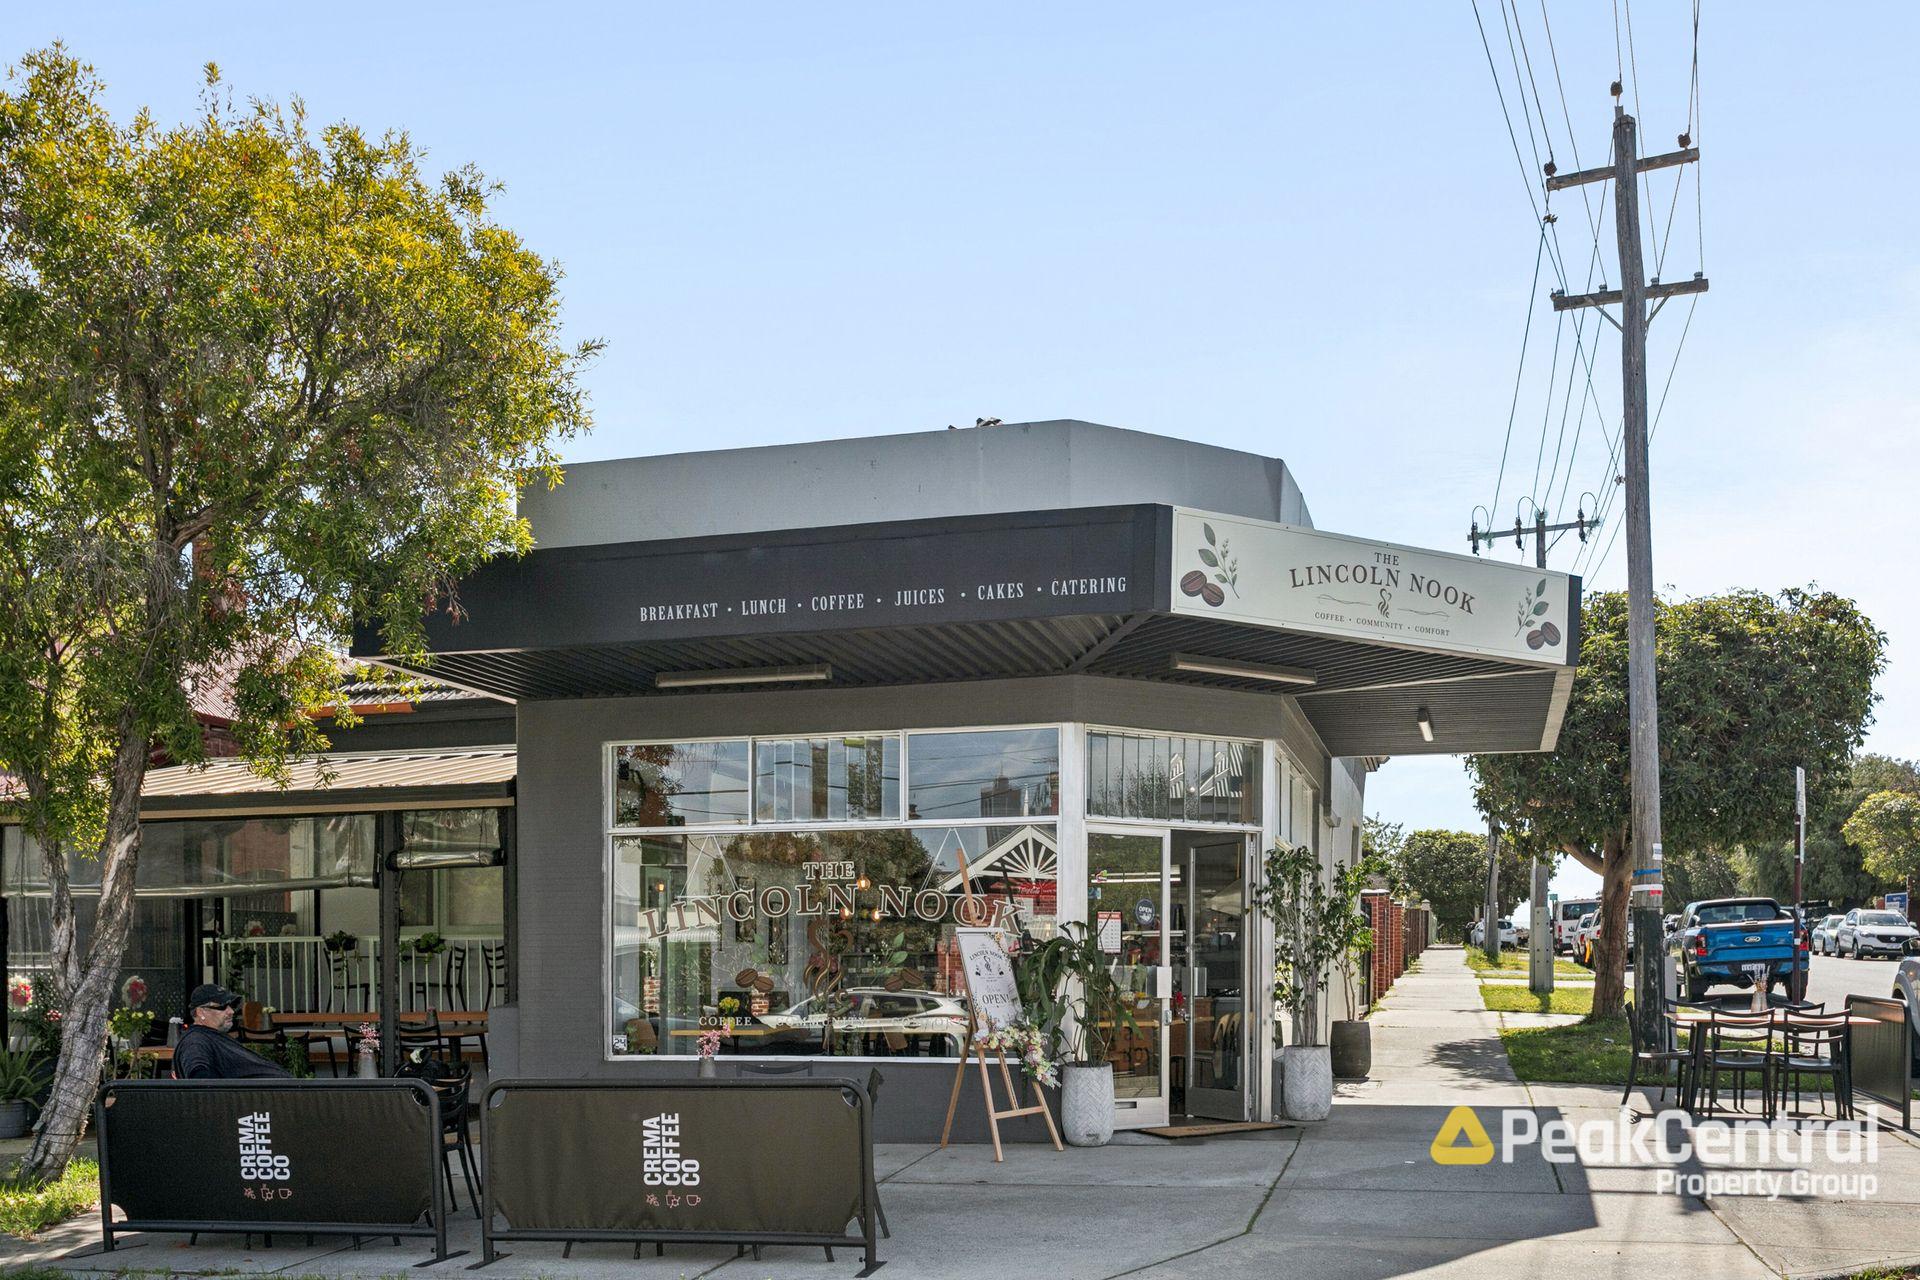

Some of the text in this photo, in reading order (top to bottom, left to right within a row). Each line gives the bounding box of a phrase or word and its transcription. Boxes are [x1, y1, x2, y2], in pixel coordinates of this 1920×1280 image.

[1374, 552, 1400, 566] THE
[640, 576, 1127, 622] BREAKFAST LUNCH COFFEE JUICES CAKES CATERING
[1289, 564, 1476, 615] LINCOLN NOOK
[1314, 611, 1450, 637] COFFEE COMMUNITY COMFORT
[802, 861, 856, 880] THE
[641, 883, 1026, 940] LINCOLN NOOK
[1138, 905, 1153, 914] OPEN
[981, 993, 1010, 1005] OPEN!
[238, 1115, 257, 1180] CREMA
[254, 1112, 274, 1180] COFFEE
[642, 1116, 662, 1186] CREMA
[661, 1113, 681, 1186] COFFEE
[273, 1155, 291, 1180] CO
[681, 1159, 700, 1186] CO
